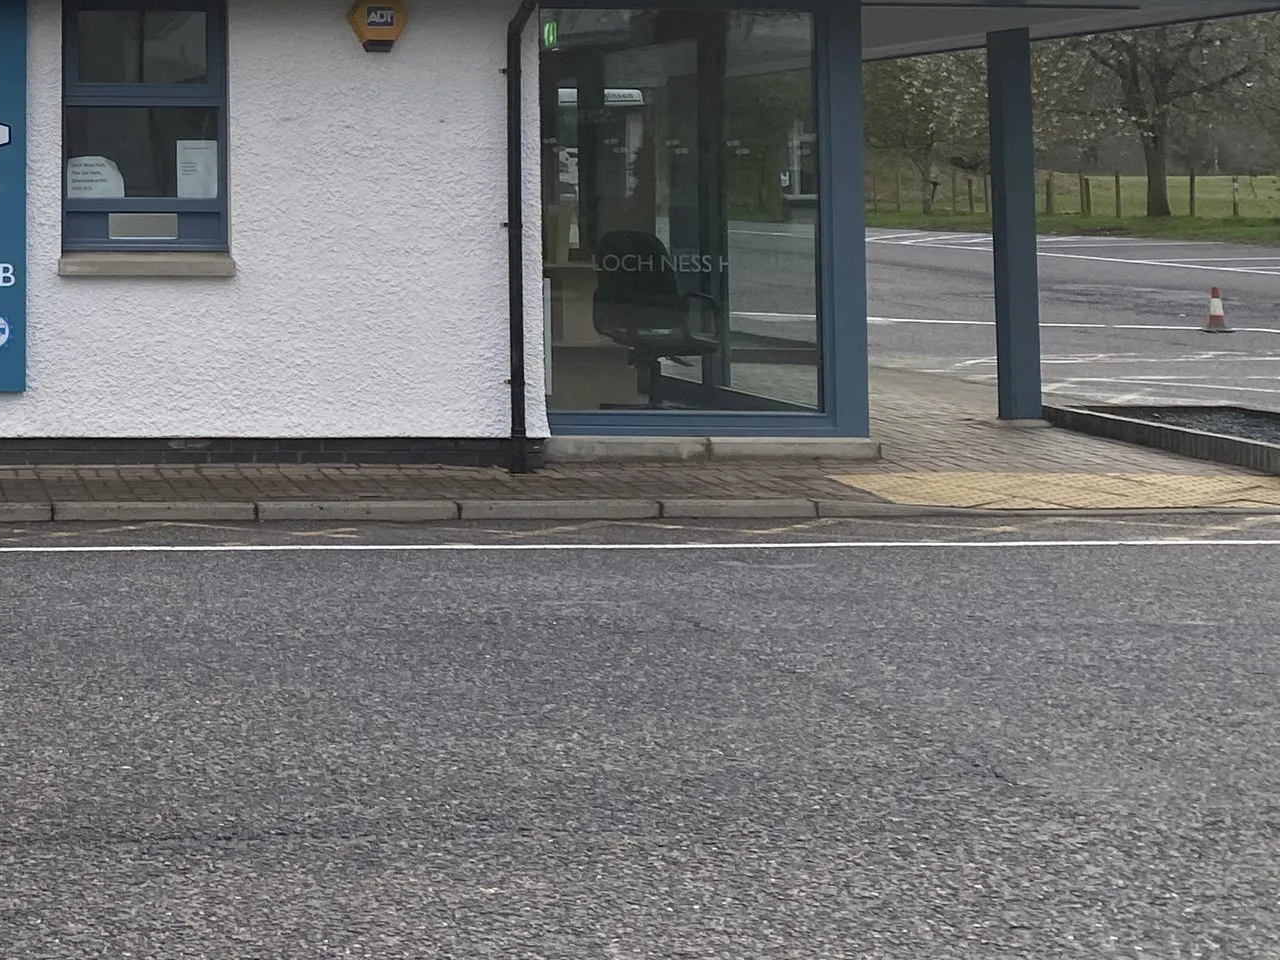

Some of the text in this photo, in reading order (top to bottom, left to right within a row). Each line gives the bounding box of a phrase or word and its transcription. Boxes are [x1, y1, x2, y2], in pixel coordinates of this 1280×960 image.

[367, 10, 395, 23] ADT
[592, 254, 654, 272] LOCH
[660, 254, 712, 273] NESS
